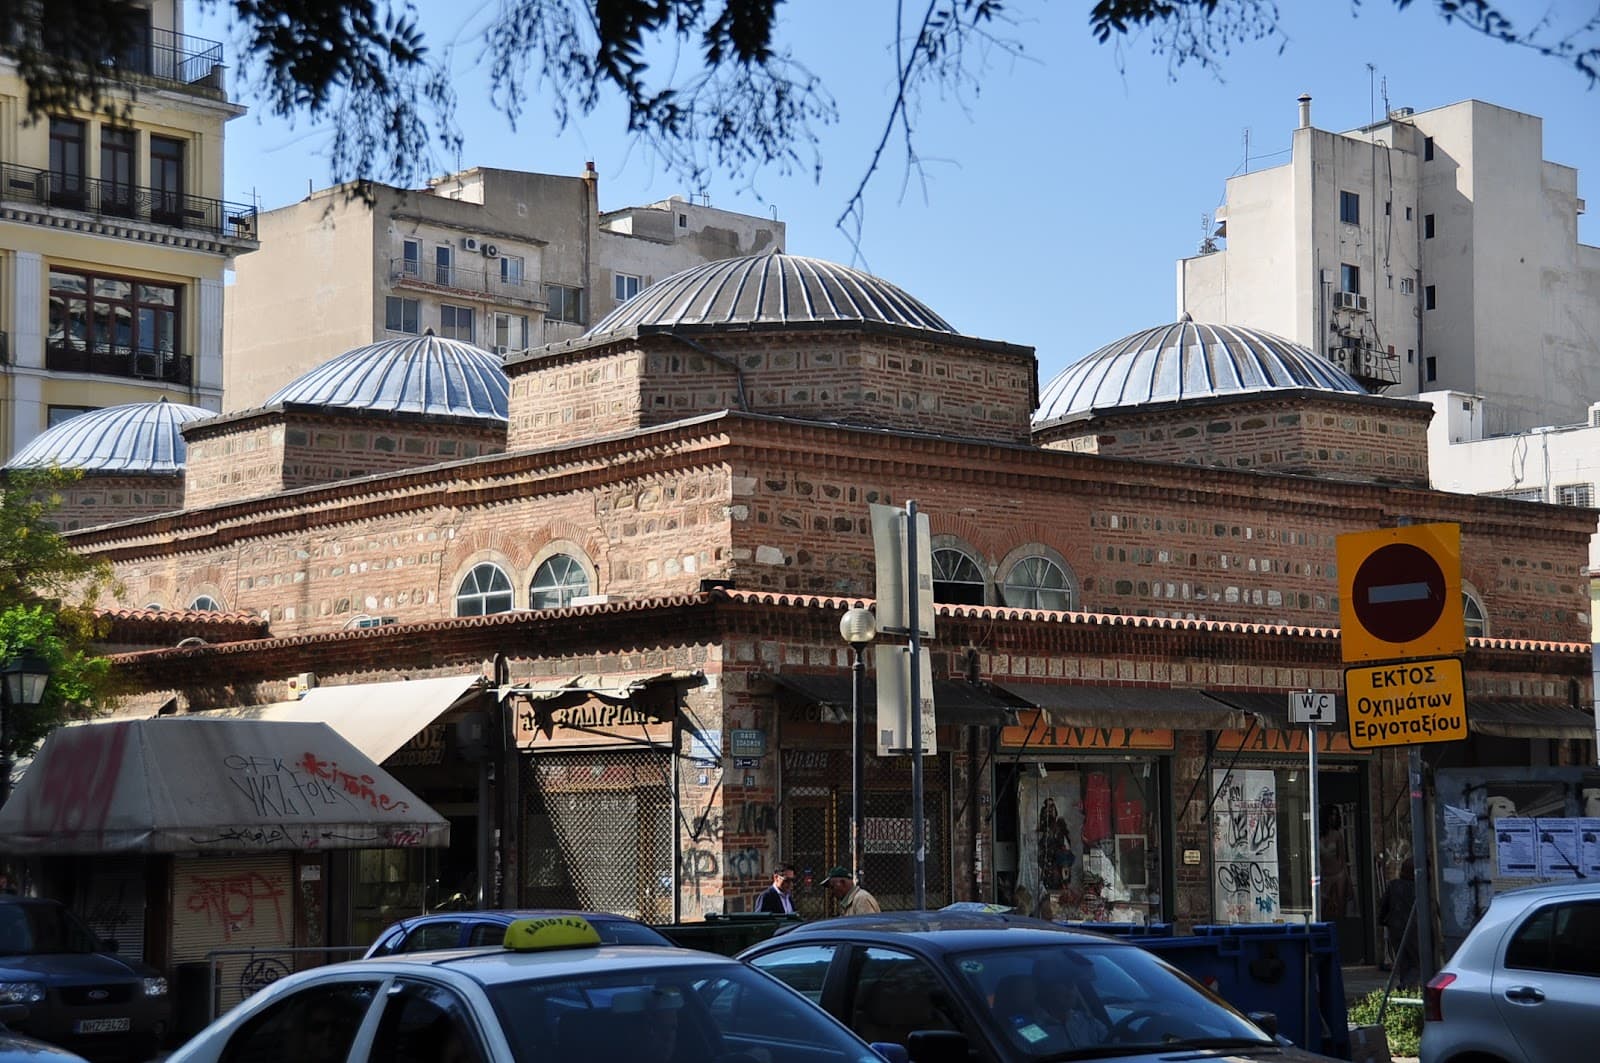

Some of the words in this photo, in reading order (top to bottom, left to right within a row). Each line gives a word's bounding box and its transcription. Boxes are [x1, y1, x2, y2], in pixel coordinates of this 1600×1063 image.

[1371, 666, 1436, 688] ΕΚΤΟΣ
[1357, 691, 1452, 718] Οχημάτων
[1355, 713, 1461, 741] Εργοταξίου
